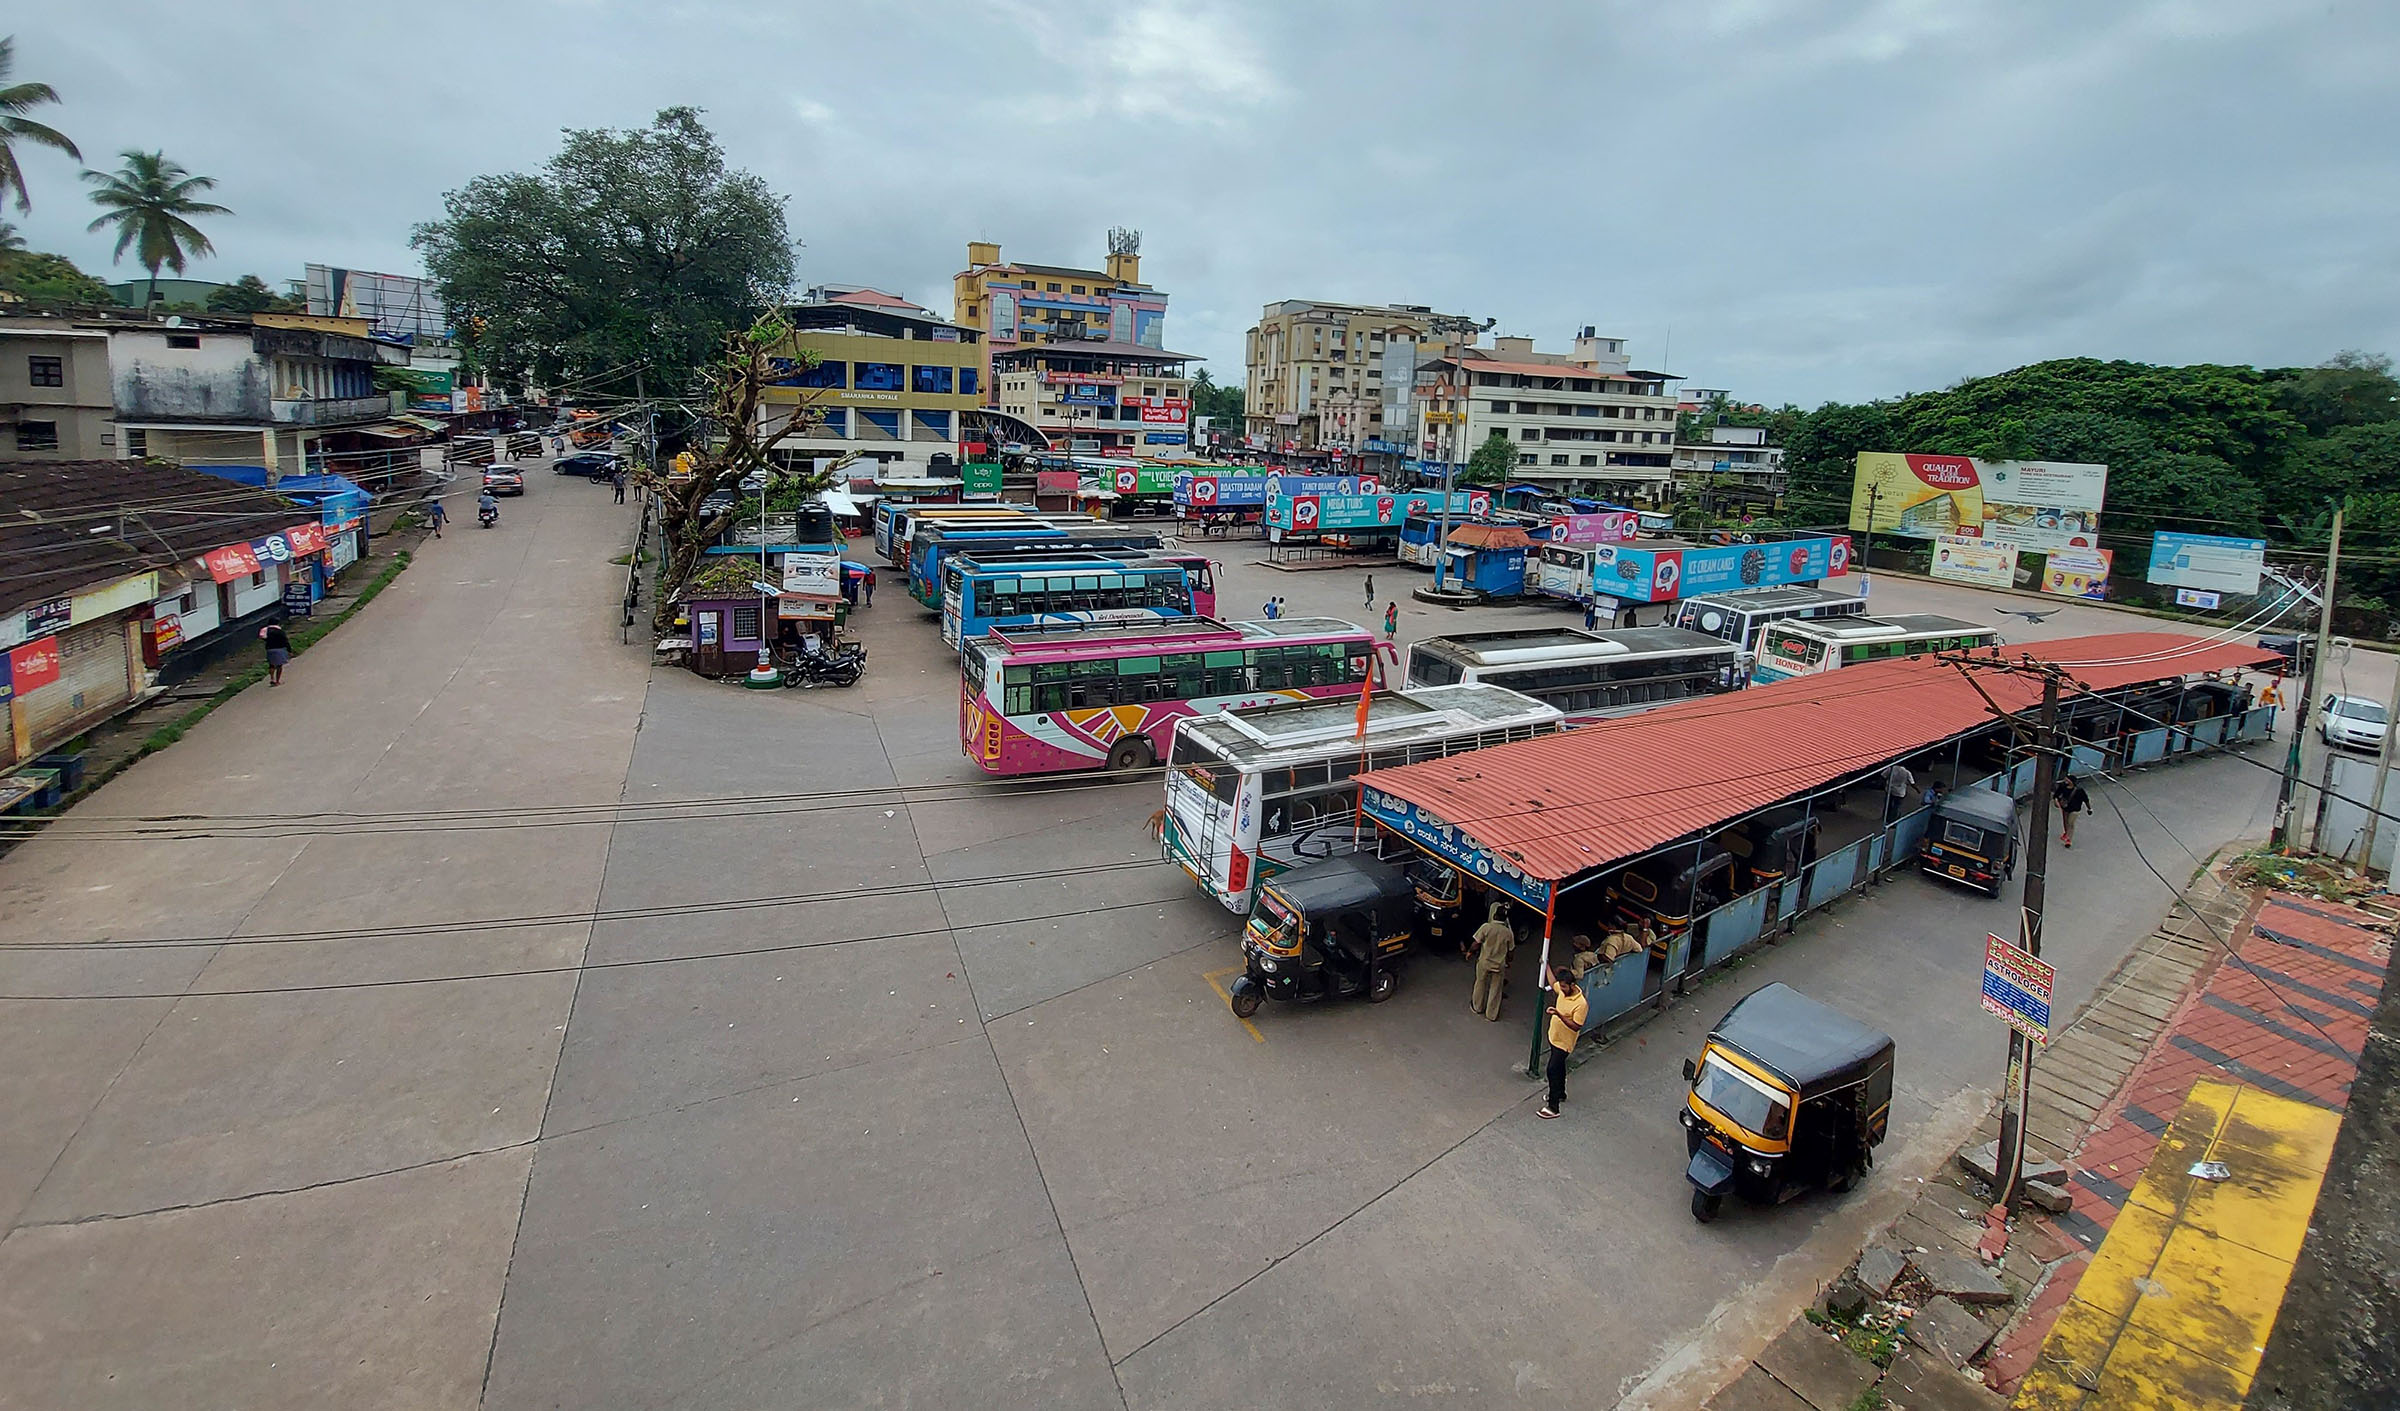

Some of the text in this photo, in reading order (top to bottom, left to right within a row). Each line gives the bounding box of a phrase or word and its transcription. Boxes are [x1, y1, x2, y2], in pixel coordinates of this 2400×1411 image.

[1922, 463, 1962, 473] QUALITY
[1927, 474, 1970, 485] TRADITION
[27, 598, 72, 621] STOP & SEE
[1775, 657, 1806, 673] HONEY
[1987, 958, 2050, 1000] ASTROLOGER
